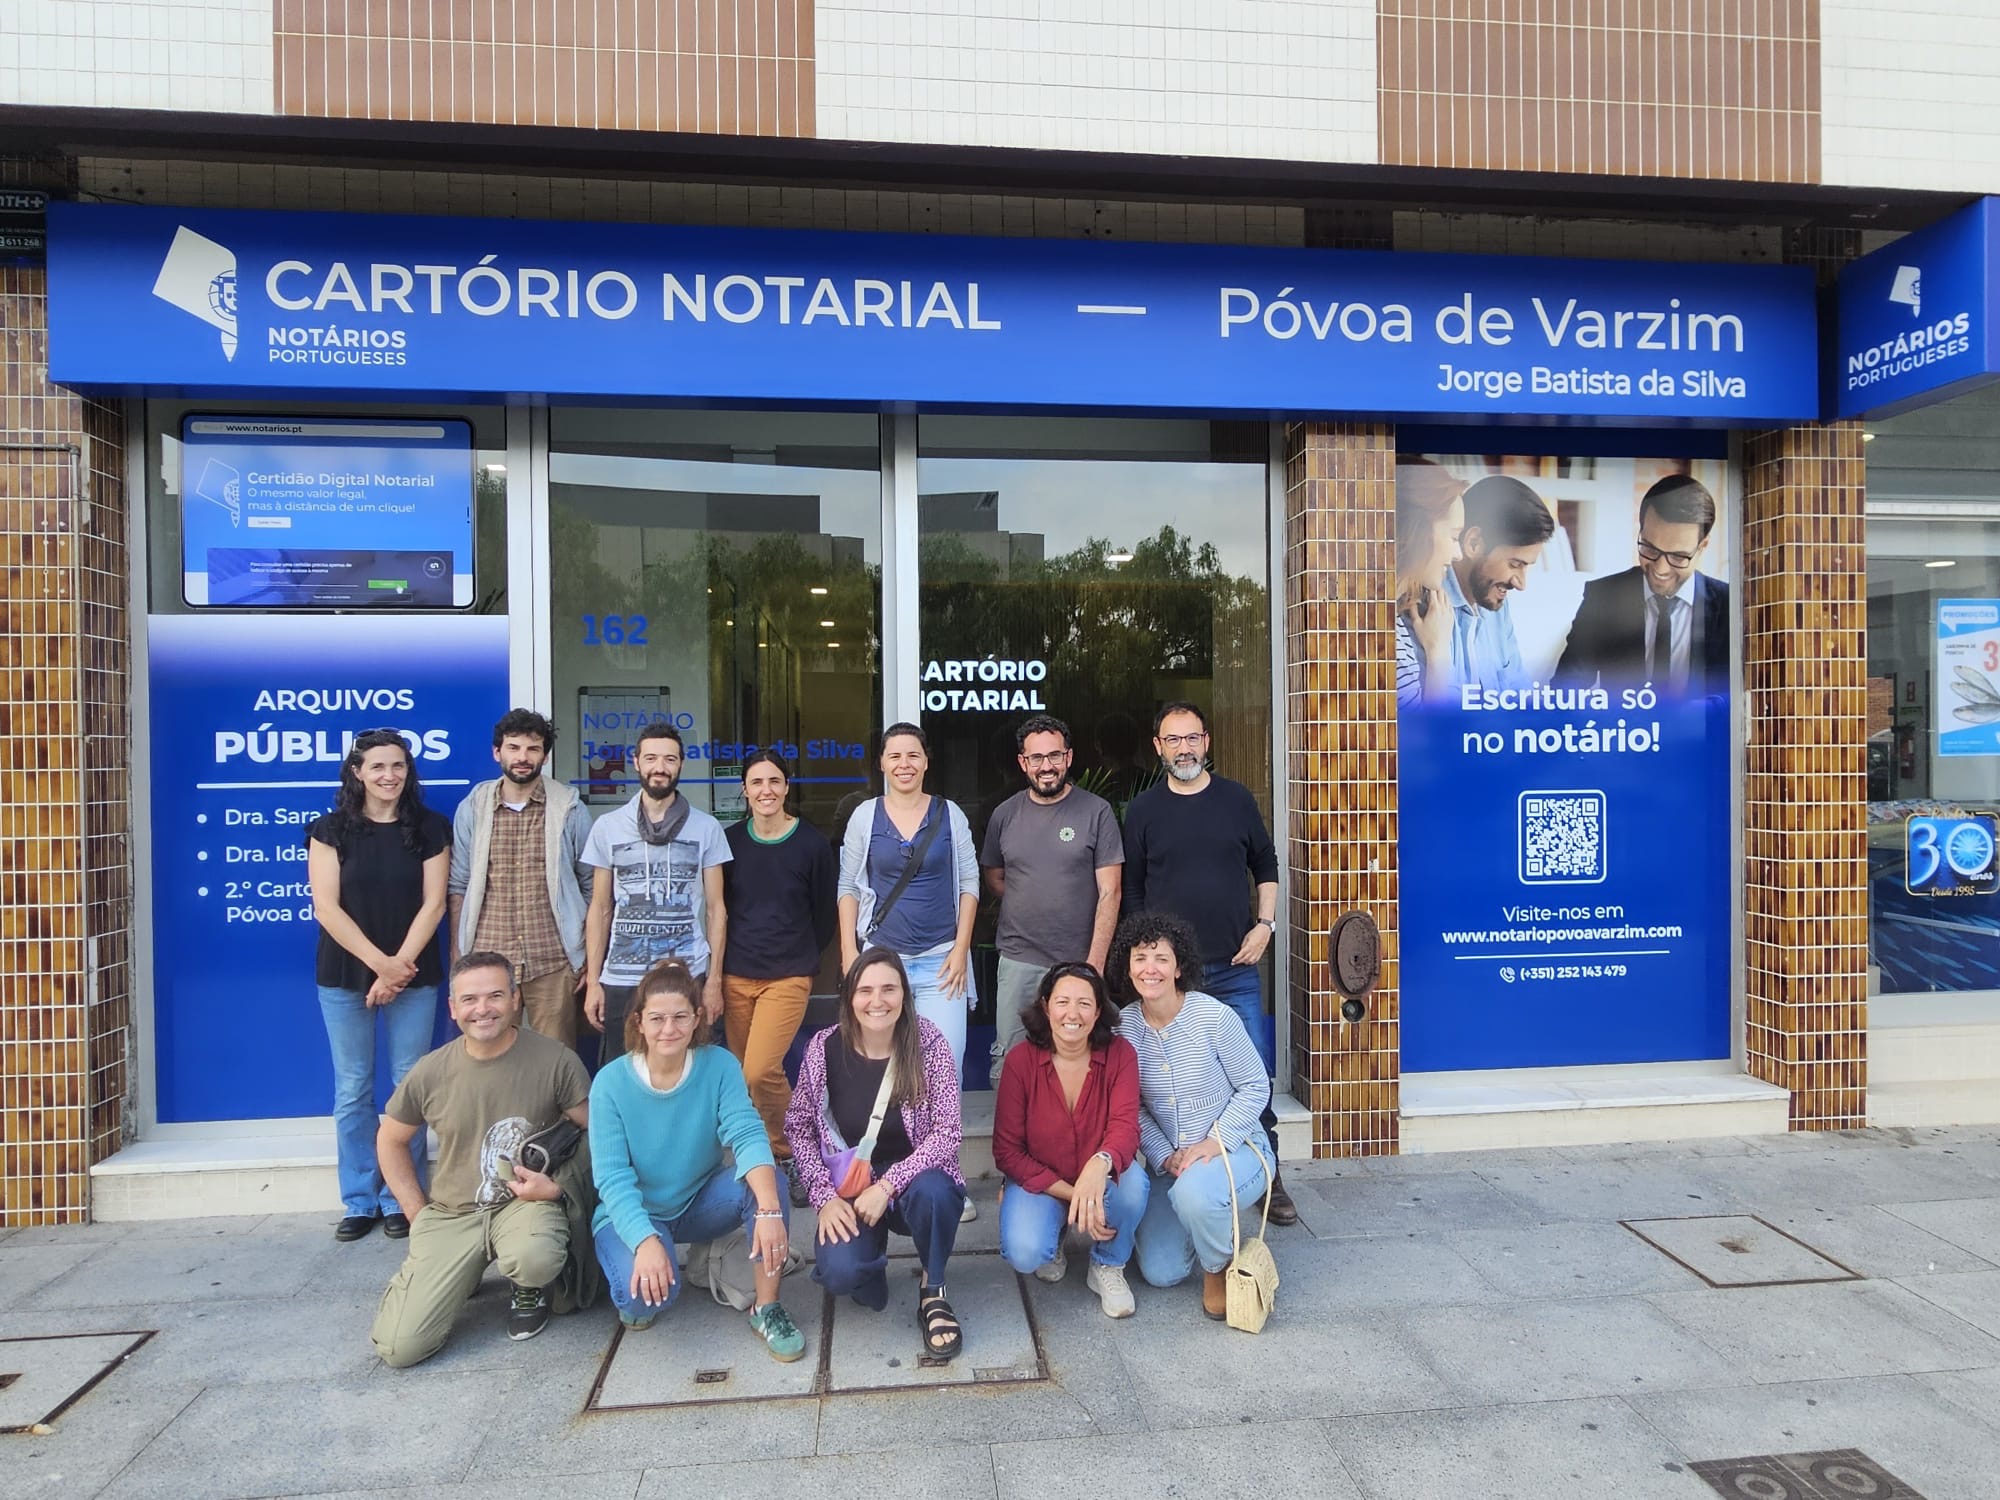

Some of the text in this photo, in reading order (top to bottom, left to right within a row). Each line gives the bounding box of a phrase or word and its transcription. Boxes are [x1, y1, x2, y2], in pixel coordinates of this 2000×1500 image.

[266, 254, 638, 320] CARTÓRIO
[663, 273, 1001, 330] NOTARIAL
[1220, 286, 1413, 343] Póvoa
[1435, 292, 1514, 345] de
[1531, 297, 1744, 352] Varzim
[268, 324, 407, 348] NOTÁRIOS
[1848, 312, 1970, 374] NOTÁRIOS
[269, 349, 407, 366] PORTUGUESES
[1848, 336, 1969, 391] PORTUGUESES
[1437, 364, 1747, 398] Jorge Batista da Silva
[226, 424, 303, 434] www.notarios.pt
[247, 472, 435, 488] Certidão Digital Notarial
[247, 487, 257, 497] O
[260, 489, 304, 498] mesmo
[306, 488, 334, 498] valor
[248, 501, 416, 514] mas à distância de um clique!
[582, 613, 649, 646] 162
[920, 653, 1047, 682] ARTÓRIO
[253, 689, 415, 715] ARQUIVOS
[1461, 681, 1657, 711] Escritura só
[215, 722, 451, 763] PÚBLIOS
[1463, 718, 1660, 754] no notário!
[583, 741, 637, 765] Jorg
[686, 739, 758, 760] atista
[806, 739, 865, 760] Silva
[225, 808, 269, 825] Dra.
[226, 845, 270, 863] Dra.
[1954, 886, 1976, 896] 1995
[227, 903, 317, 923] Póvoa d
[1503, 905, 1624, 922] Visite-nos em
[1442, 924, 1683, 944] www.notariopovoavarzim.com
[1520, 965, 1627, 981] (+351) 252 143 479
